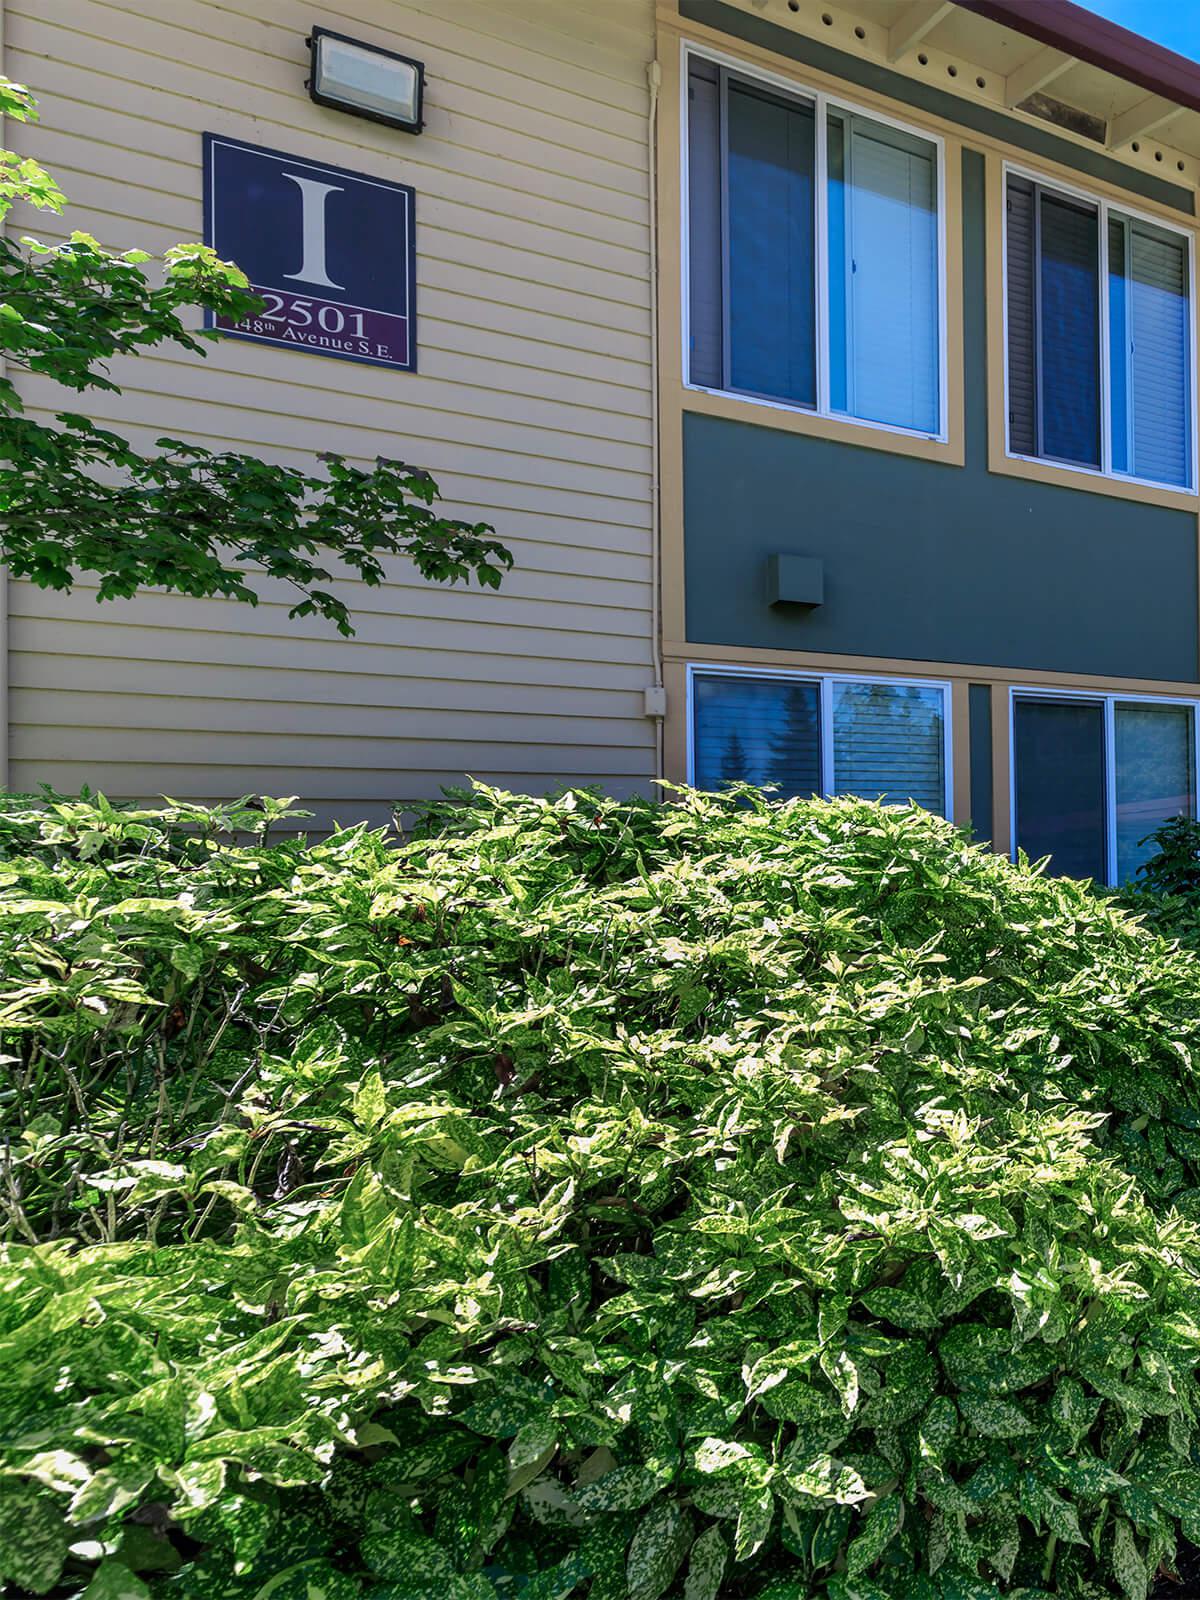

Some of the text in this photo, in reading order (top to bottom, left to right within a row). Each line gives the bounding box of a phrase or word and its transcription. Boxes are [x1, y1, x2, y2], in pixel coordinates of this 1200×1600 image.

[282, 172, 345, 291] I
[259, 294, 370, 339] 2501
[282, 327, 353, 351] Avenue
